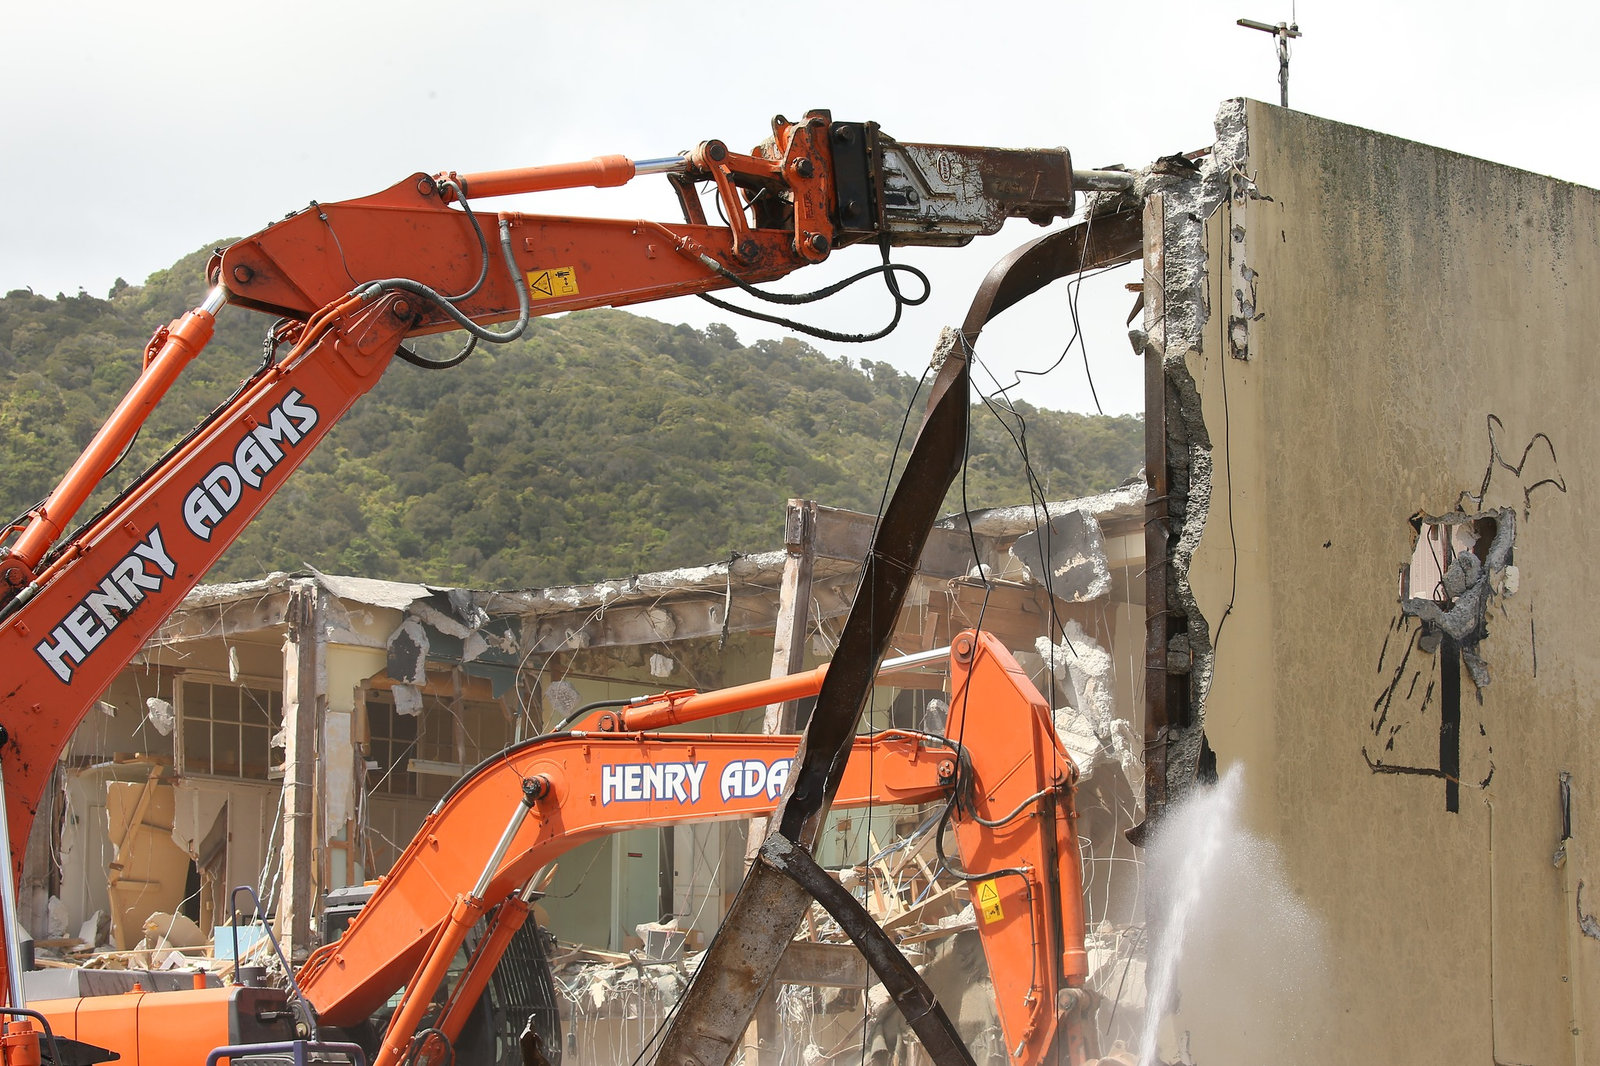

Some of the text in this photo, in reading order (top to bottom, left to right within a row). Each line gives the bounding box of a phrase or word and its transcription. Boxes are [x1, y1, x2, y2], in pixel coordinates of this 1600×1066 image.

[35, 388, 318, 685] HENRY ADAMS
[602, 758, 795, 807] HENRY ADA
